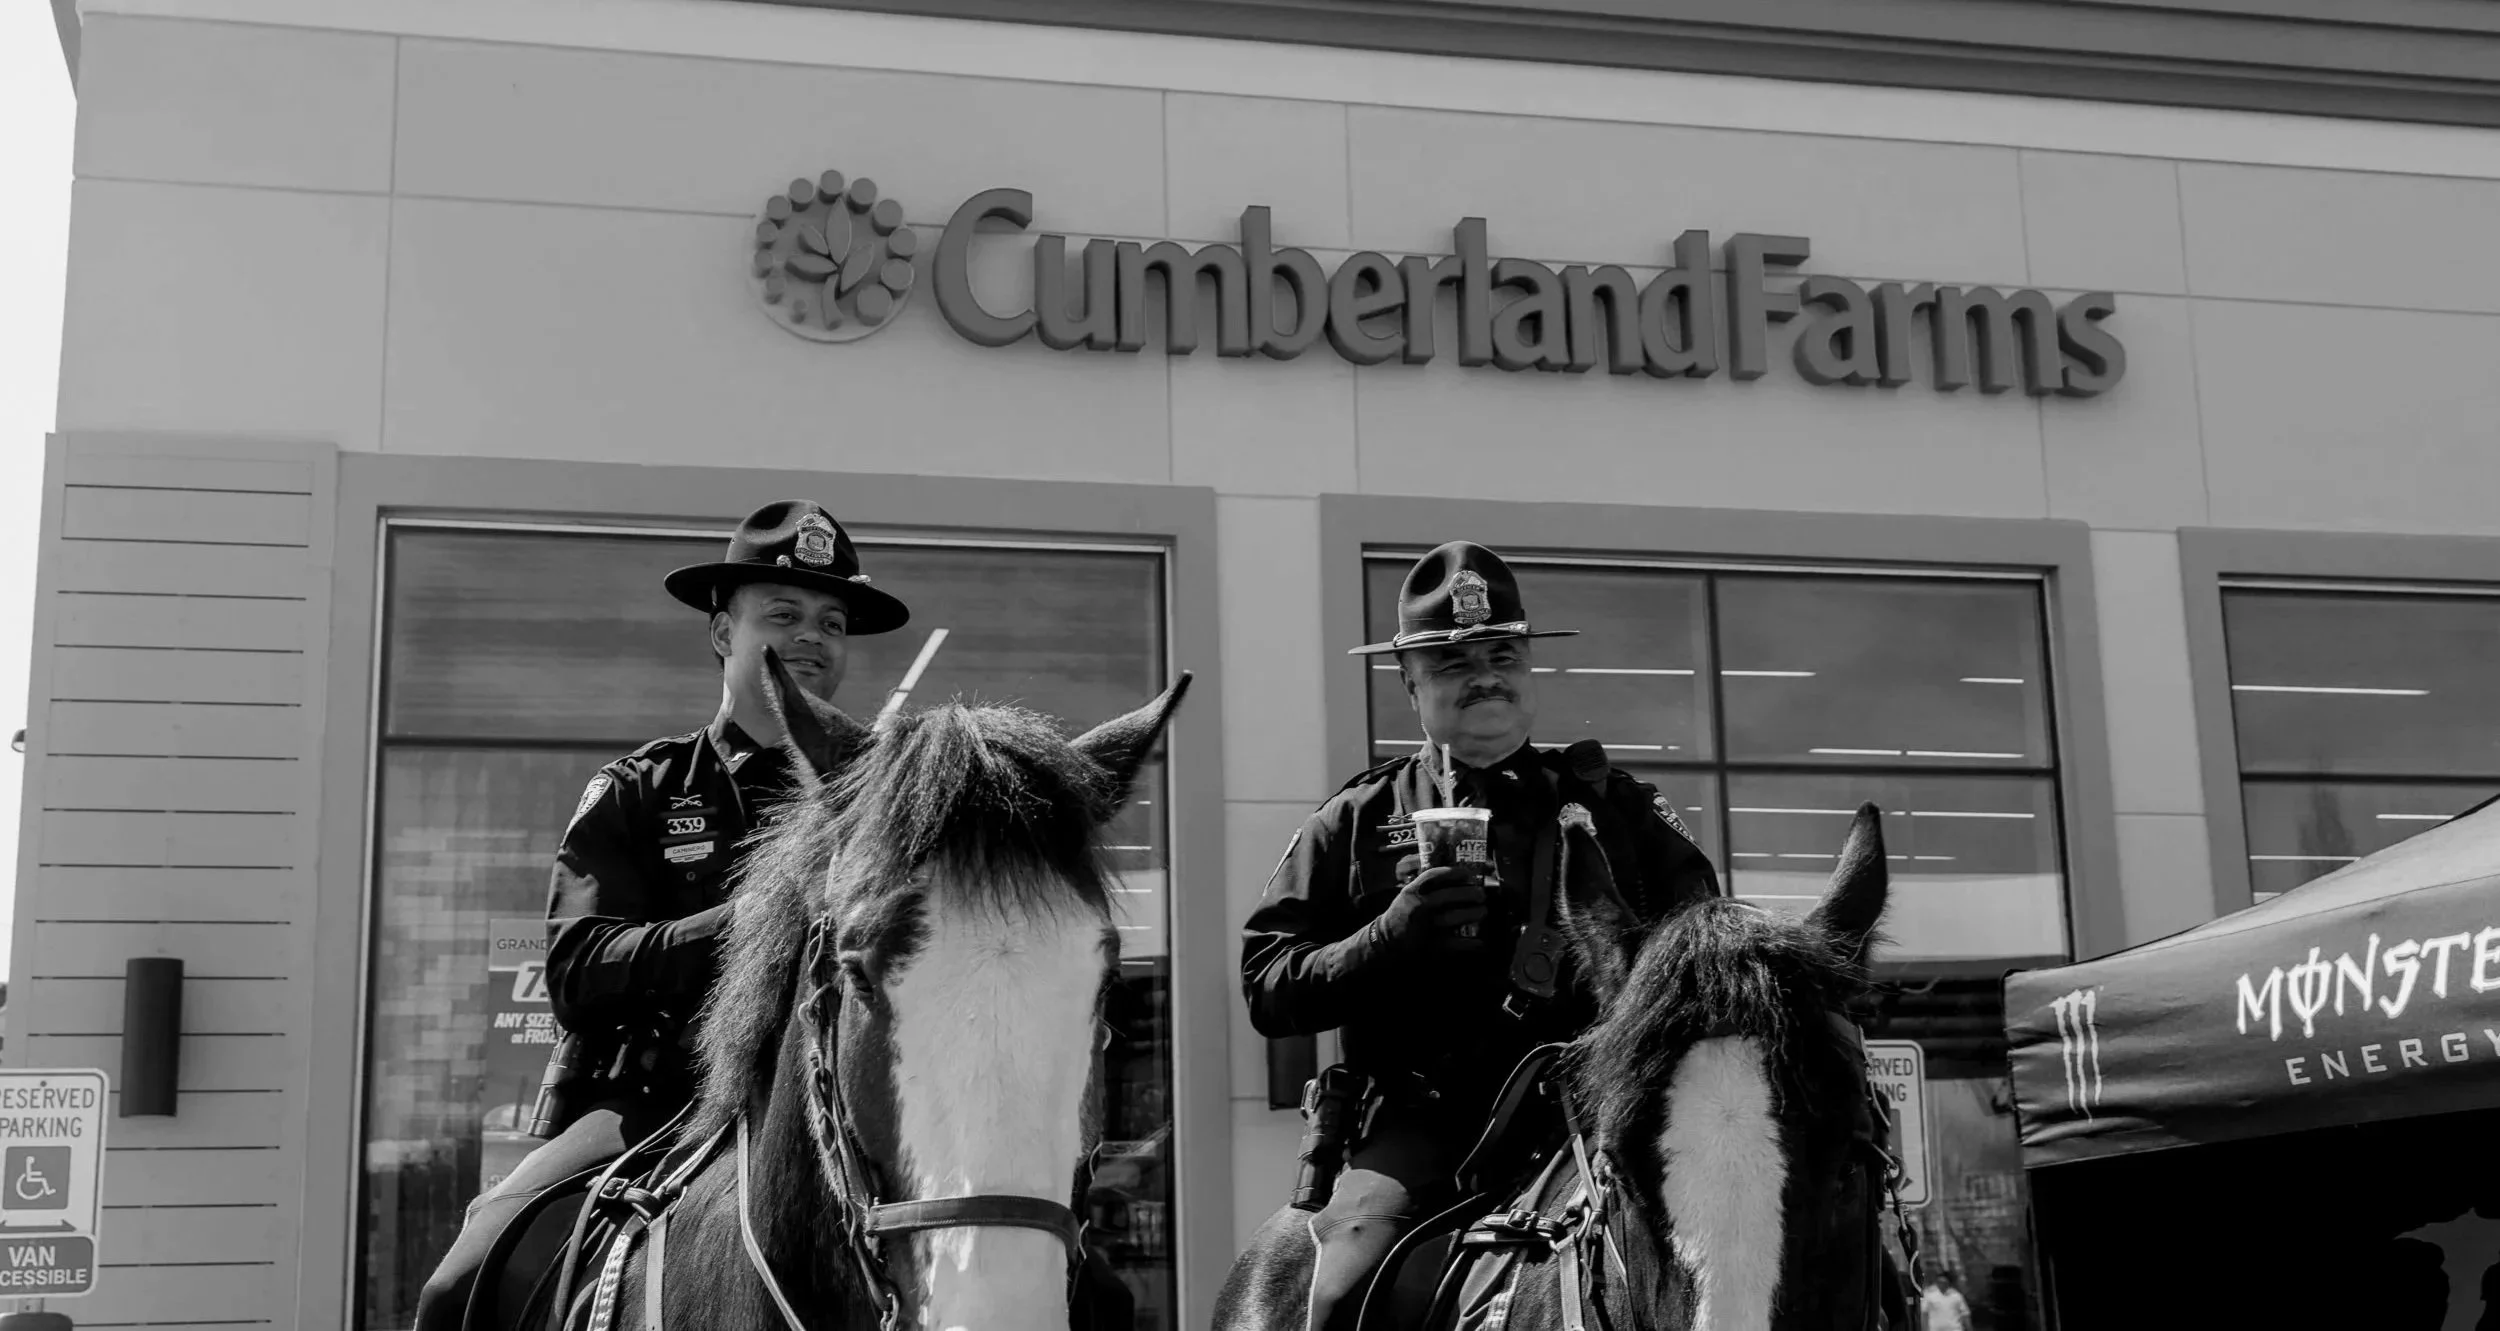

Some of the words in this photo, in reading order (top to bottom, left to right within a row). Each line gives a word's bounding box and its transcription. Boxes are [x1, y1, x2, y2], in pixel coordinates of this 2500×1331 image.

[930, 186, 1718, 380] Cumberland
[1724, 231, 2128, 398] Farms
[667, 816, 706, 835] 339
[494, 1012, 525, 1028] ANY
[525, 1012, 555, 1028] SIZE
[0, 1087, 95, 1109] ESERVED
[0, 1116, 82, 1138] PARKING
[8, 1245, 56, 1267] VAN
